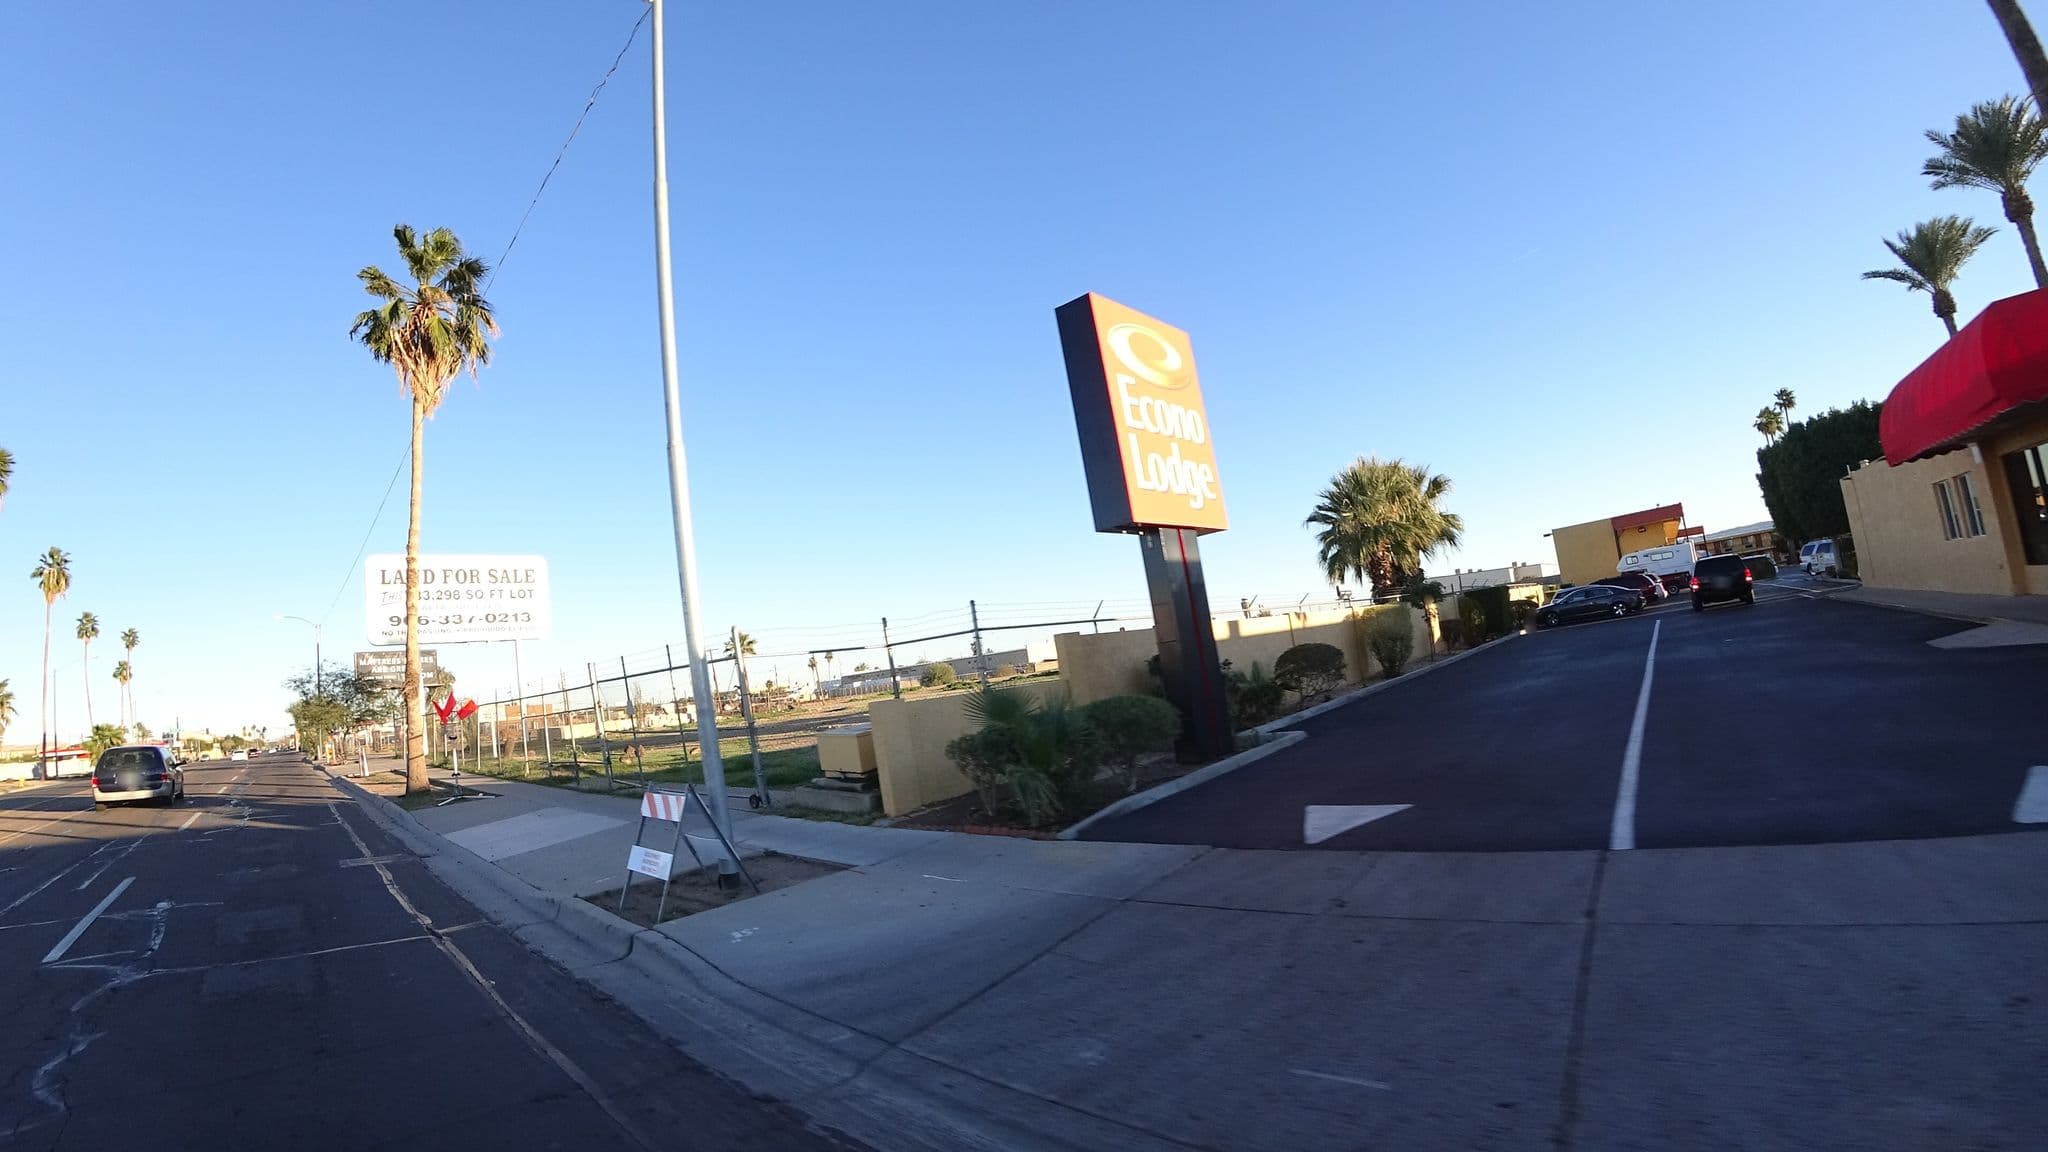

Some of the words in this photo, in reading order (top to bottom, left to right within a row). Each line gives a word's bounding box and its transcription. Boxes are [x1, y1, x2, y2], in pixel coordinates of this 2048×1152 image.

[1116, 374, 1206, 445] Econo
[1128, 432, 1217, 509] Lodge
[381, 569, 435, 585] LAD
[443, 569, 481, 584] FOR
[488, 568, 536, 584] SALE
[490, 589, 505, 599] FT
[510, 588, 534, 599] LOT
[389, 611, 532, 627] 96-337-0213
